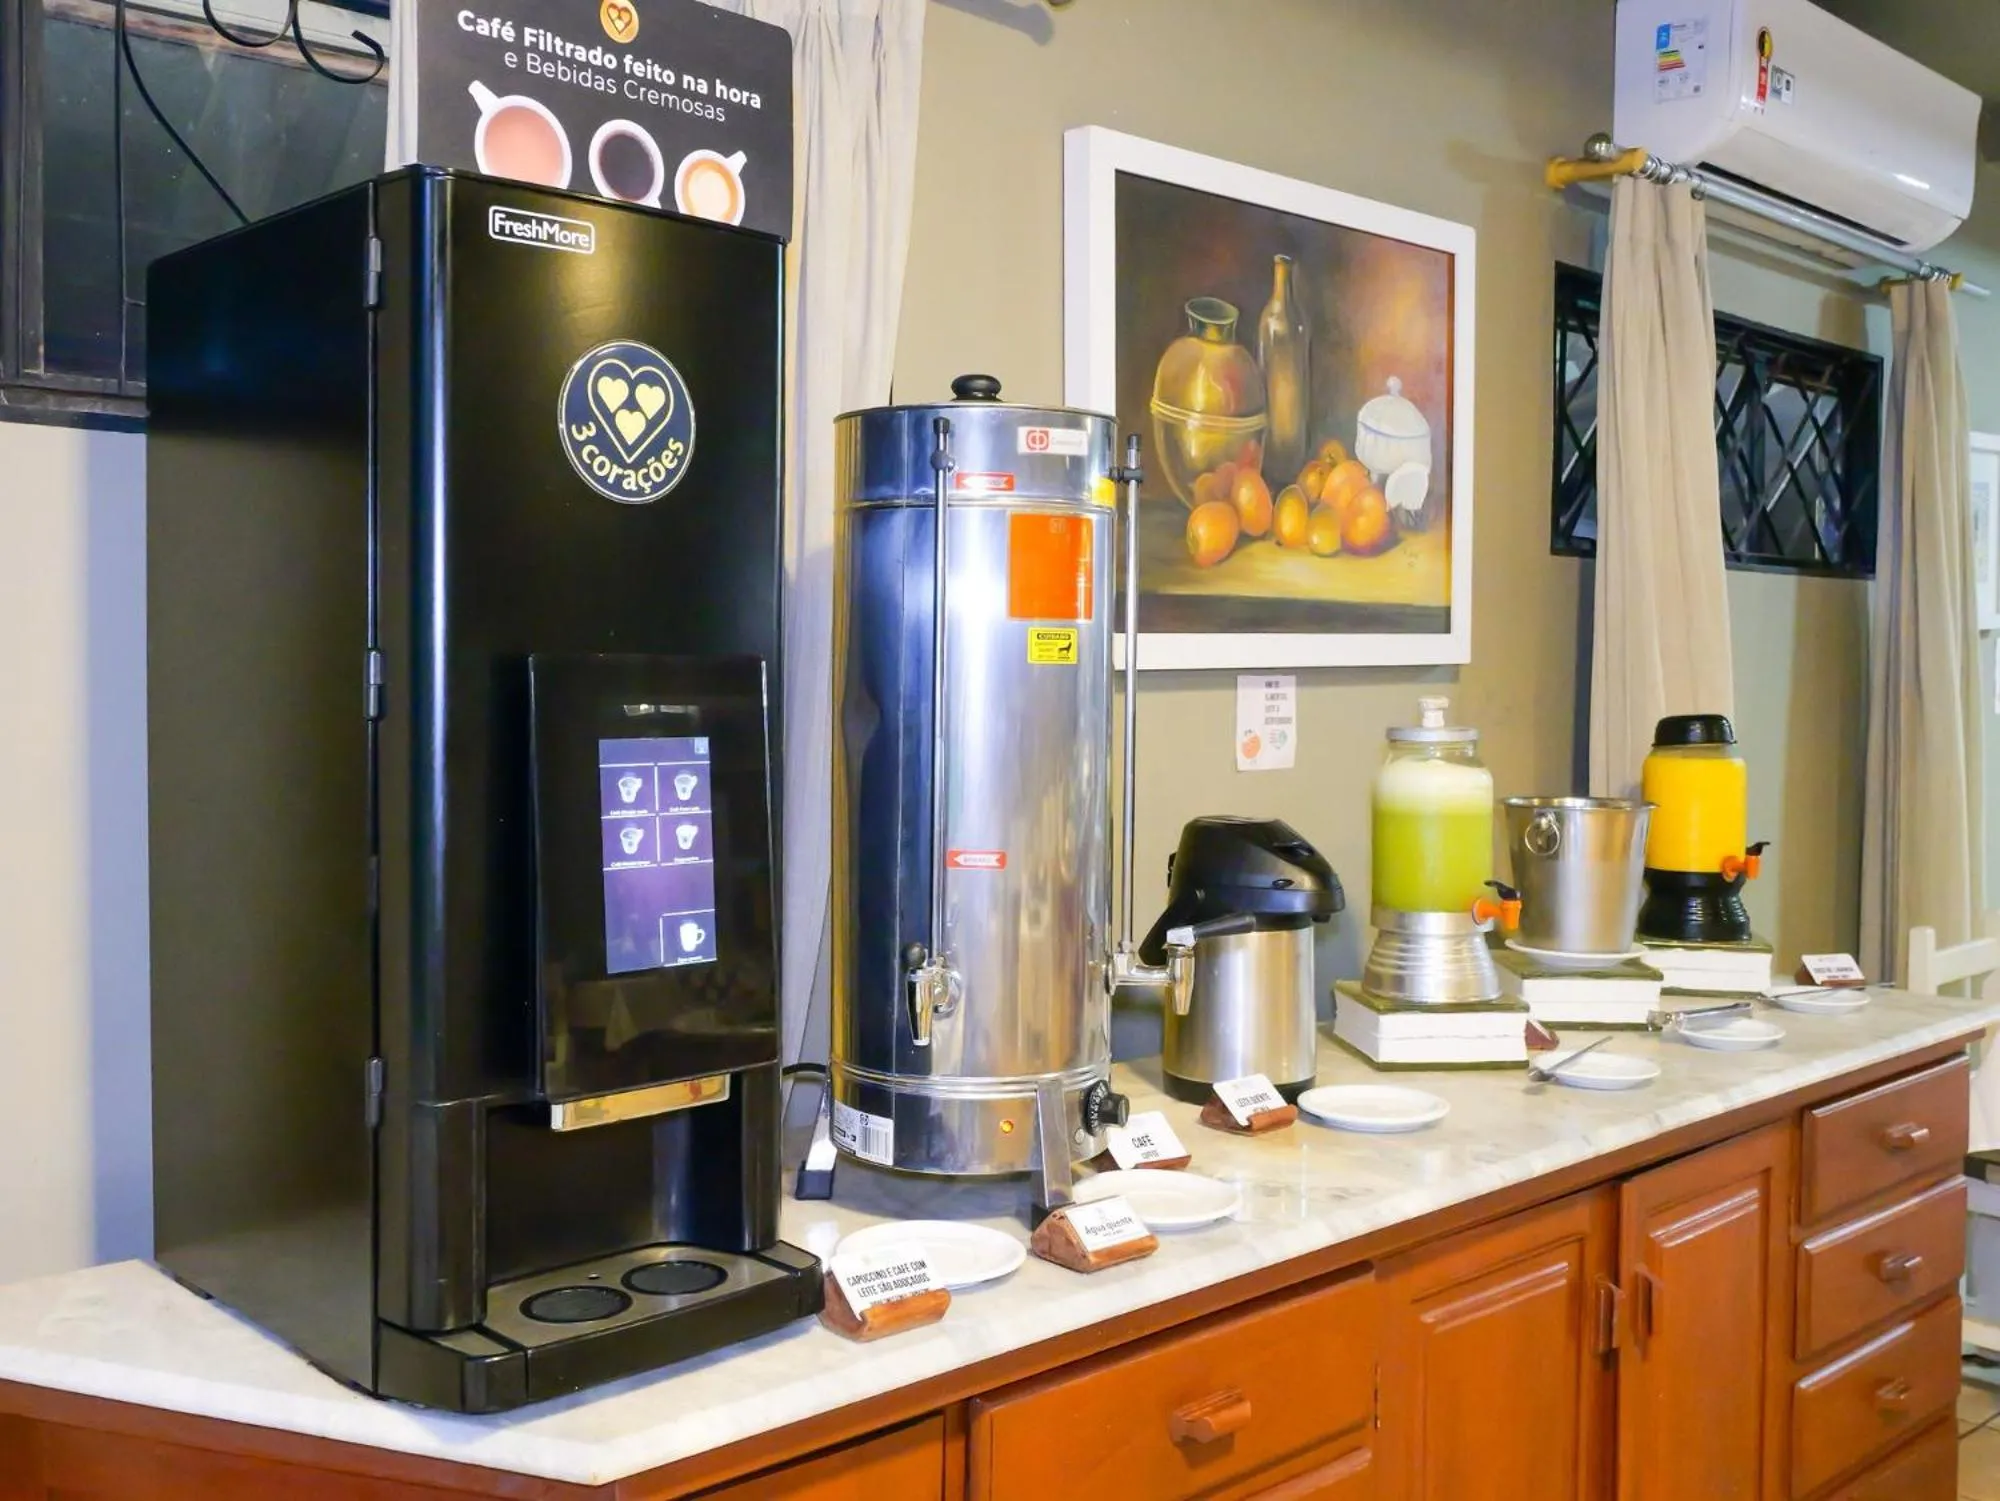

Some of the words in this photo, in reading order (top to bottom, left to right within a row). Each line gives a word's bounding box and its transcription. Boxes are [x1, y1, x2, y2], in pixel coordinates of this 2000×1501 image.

[457, 9, 515, 42] Café
[524, 27, 617, 69] Filtrado
[623, 54, 675, 85] feito
[683, 72, 709, 95] na
[715, 76, 761, 109] hora
[504, 51, 518, 68] e
[526, 53, 617, 94] Bebidas
[624, 79, 726, 122] Cremosas
[493, 212, 591, 248] FreshMore
[571, 421, 597, 441] 3
[581, 437, 684, 494] corações
[886, 1267, 894, 1278] E
[910, 1260, 928, 1272] COM
[857, 1284, 879, 1298] LEITE
